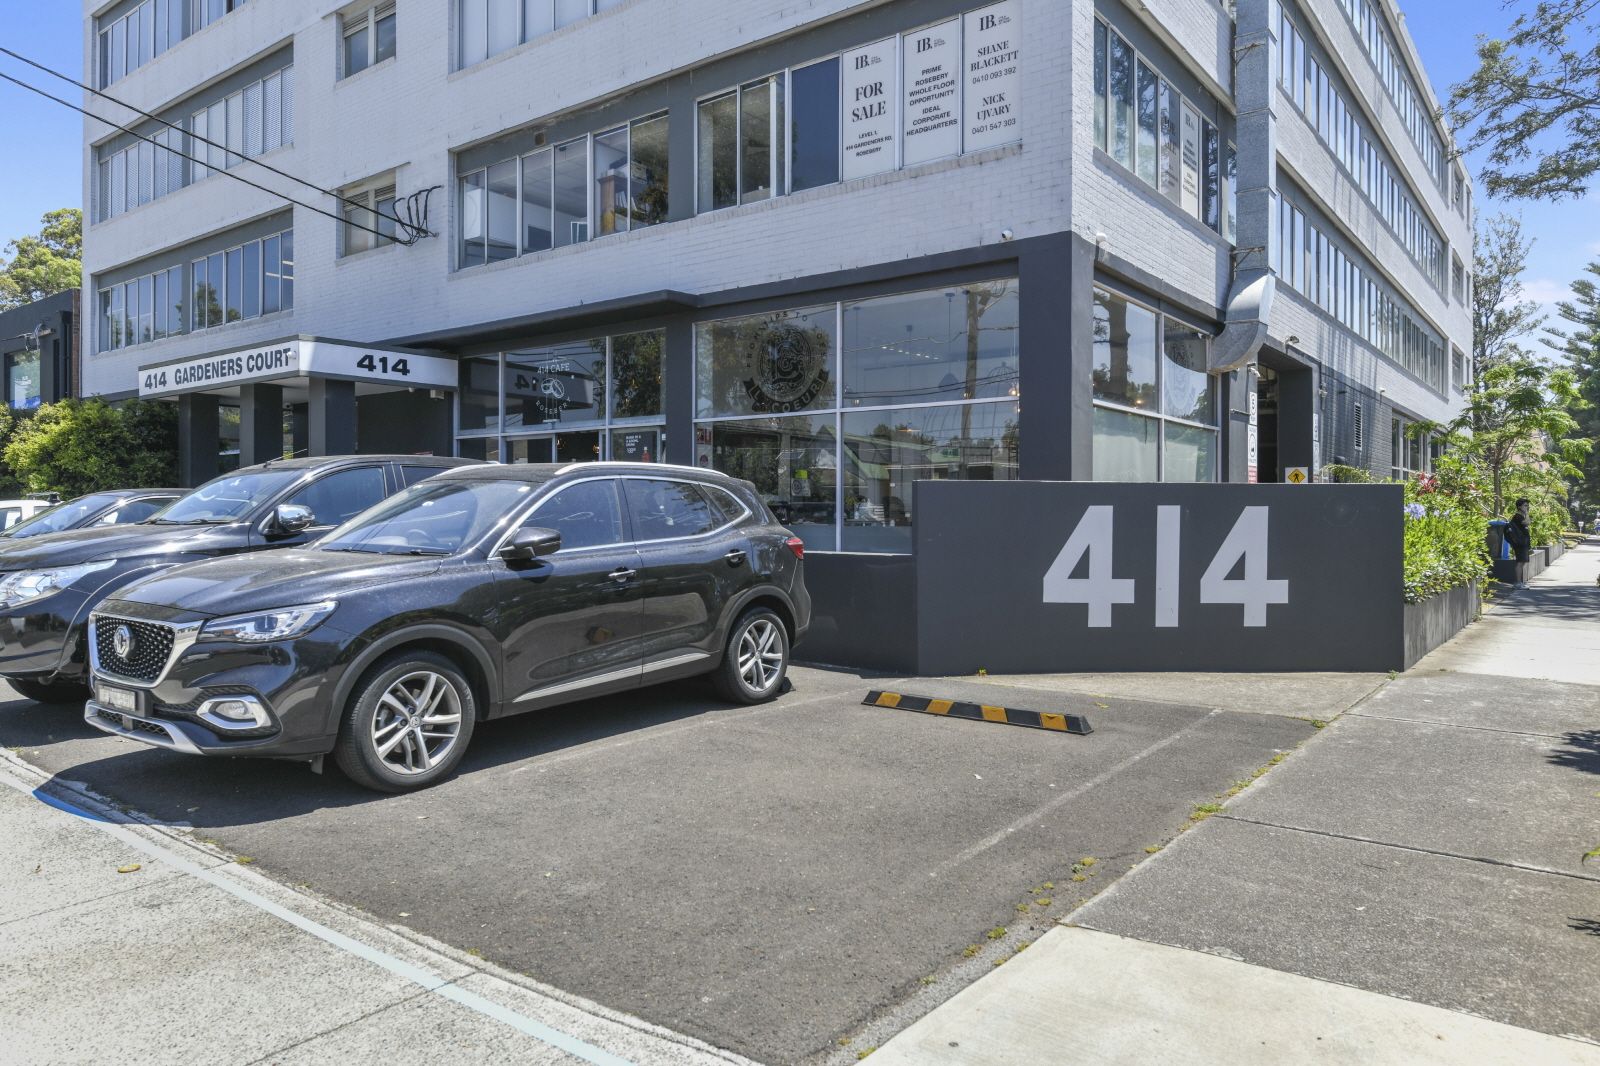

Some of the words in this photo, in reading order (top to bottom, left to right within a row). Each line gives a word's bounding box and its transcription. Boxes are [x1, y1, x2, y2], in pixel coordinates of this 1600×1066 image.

[977, 40, 1009, 57] SHANE
[970, 50, 1019, 72] BLACKETT
[915, 72, 949, 86] ROSEBERY
[921, 65, 942, 76] PRIME
[972, 73, 989, 84] 0410
[990, 70, 1002, 80] 093
[1004, 66, 1017, 76] 392
[855, 81, 883, 101] FOR
[909, 86, 933, 97] WHOLE
[933, 80, 955, 91] FLOOR
[909, 89, 954, 106] OPPORTUNITY
[982, 92, 1005, 106] NICK
[852, 100, 886, 122] SALE
[922, 105, 941, 114] IDEAL
[977, 103, 1011, 121] UJVARY
[912, 111, 951, 126] CORPORATE
[972, 125, 988, 135] 0401
[989, 121, 1002, 131] 547
[1003, 118, 1016, 127] 303
[906, 119, 958, 137] HEADQUARTERS
[144, 370, 167, 390] 414
[174, 356, 243, 386] GARDENERS
[246, 347, 291, 374] COURT
[356, 354, 411, 376] 414
[1042, 504, 1289, 627] 414
